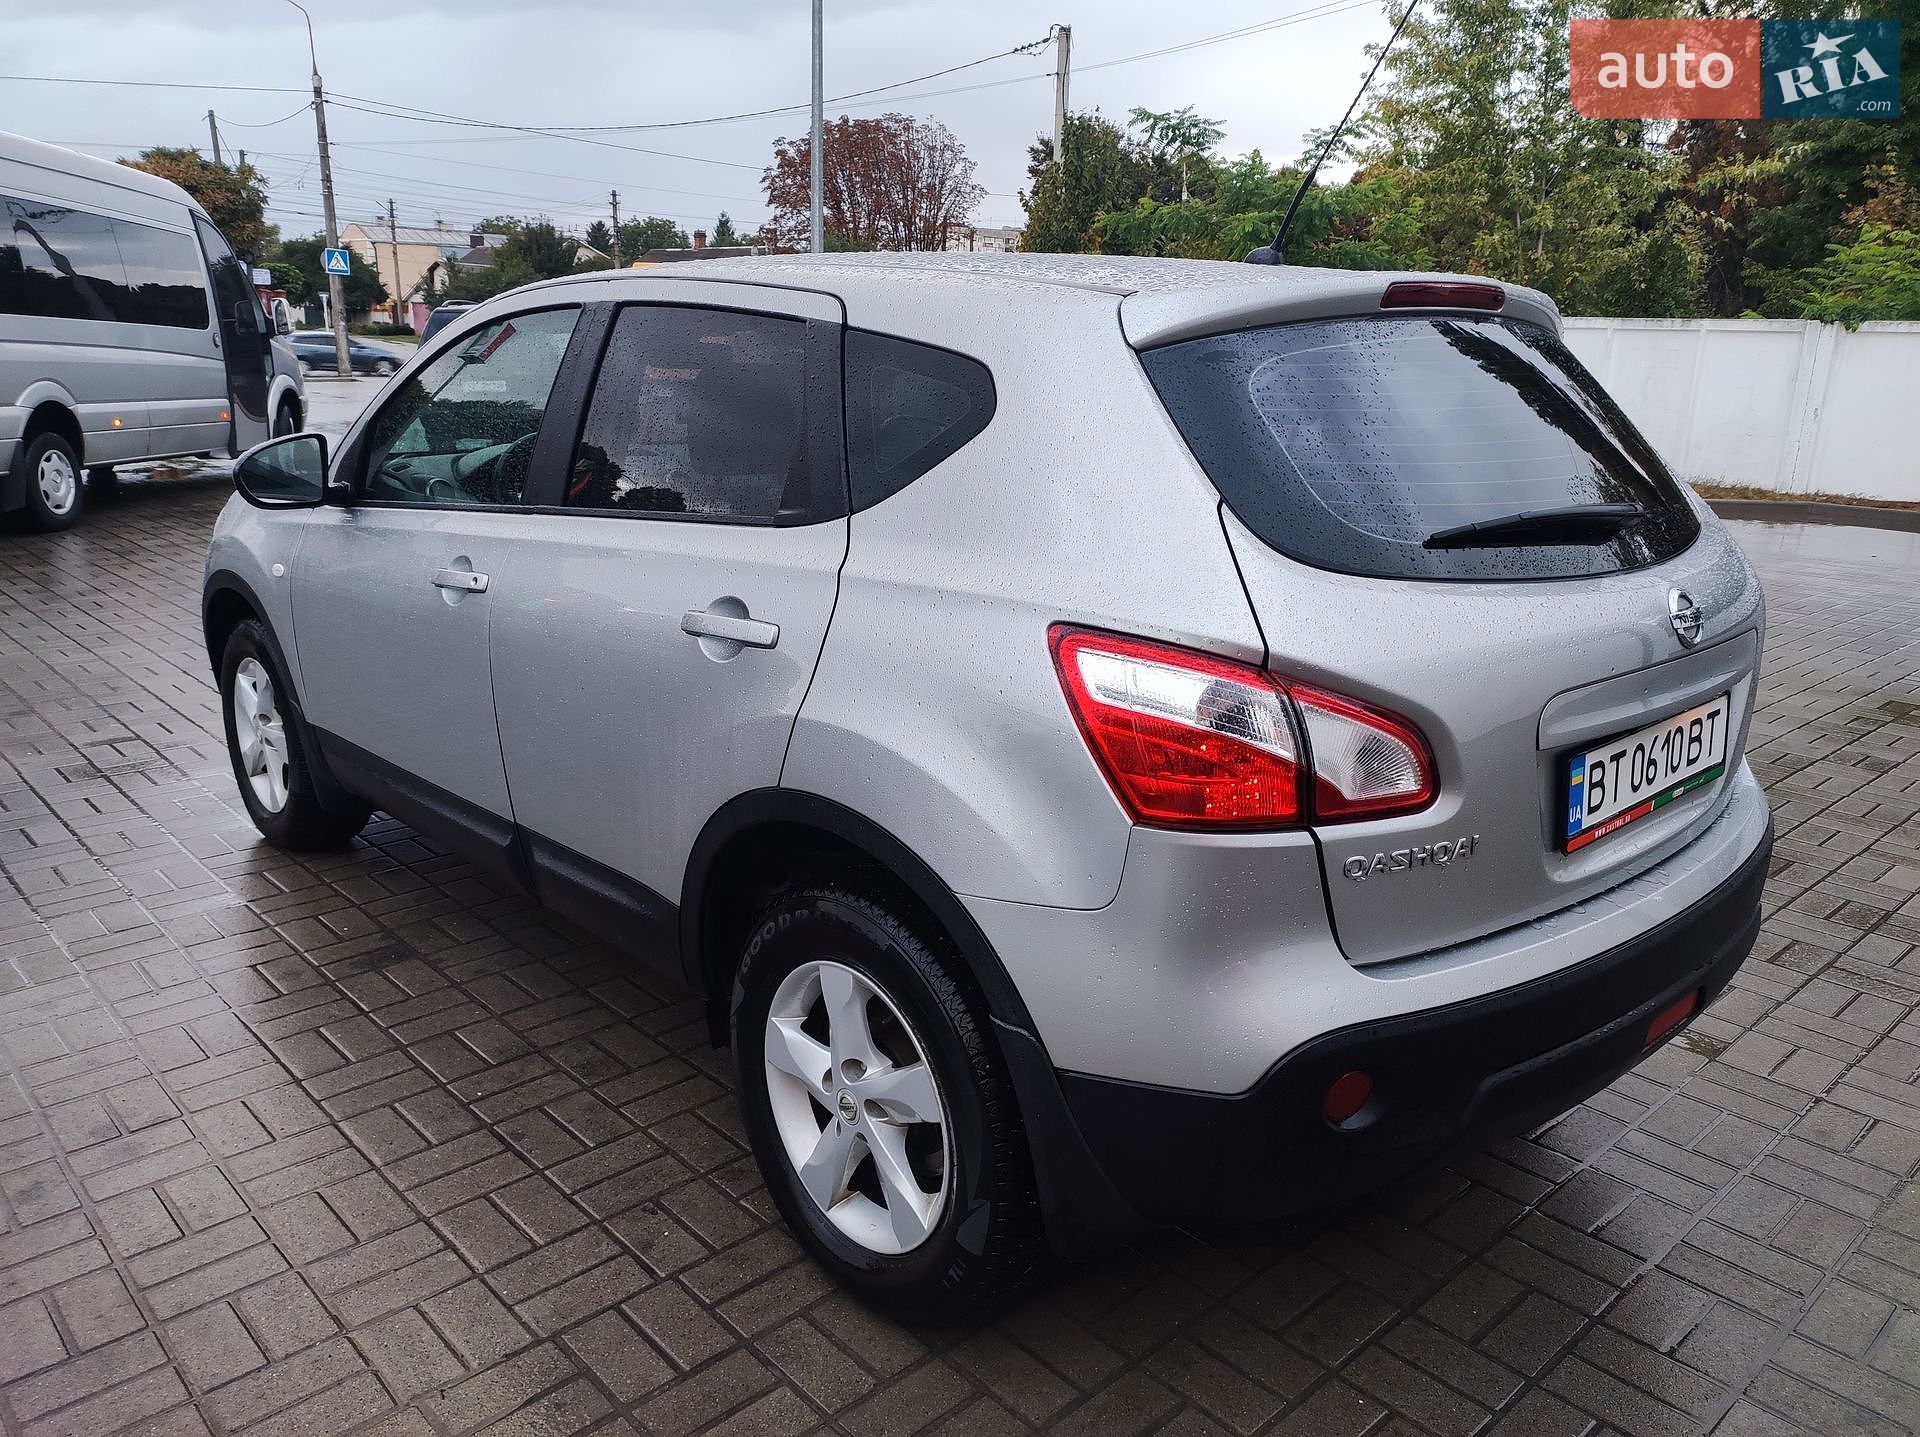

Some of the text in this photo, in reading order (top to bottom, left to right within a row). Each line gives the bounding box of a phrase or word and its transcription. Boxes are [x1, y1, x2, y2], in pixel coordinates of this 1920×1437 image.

[1587, 708, 1721, 816] BT0610BT
[1569, 806, 1582, 823] UA
[1343, 834, 1480, 881] QASHQAI
